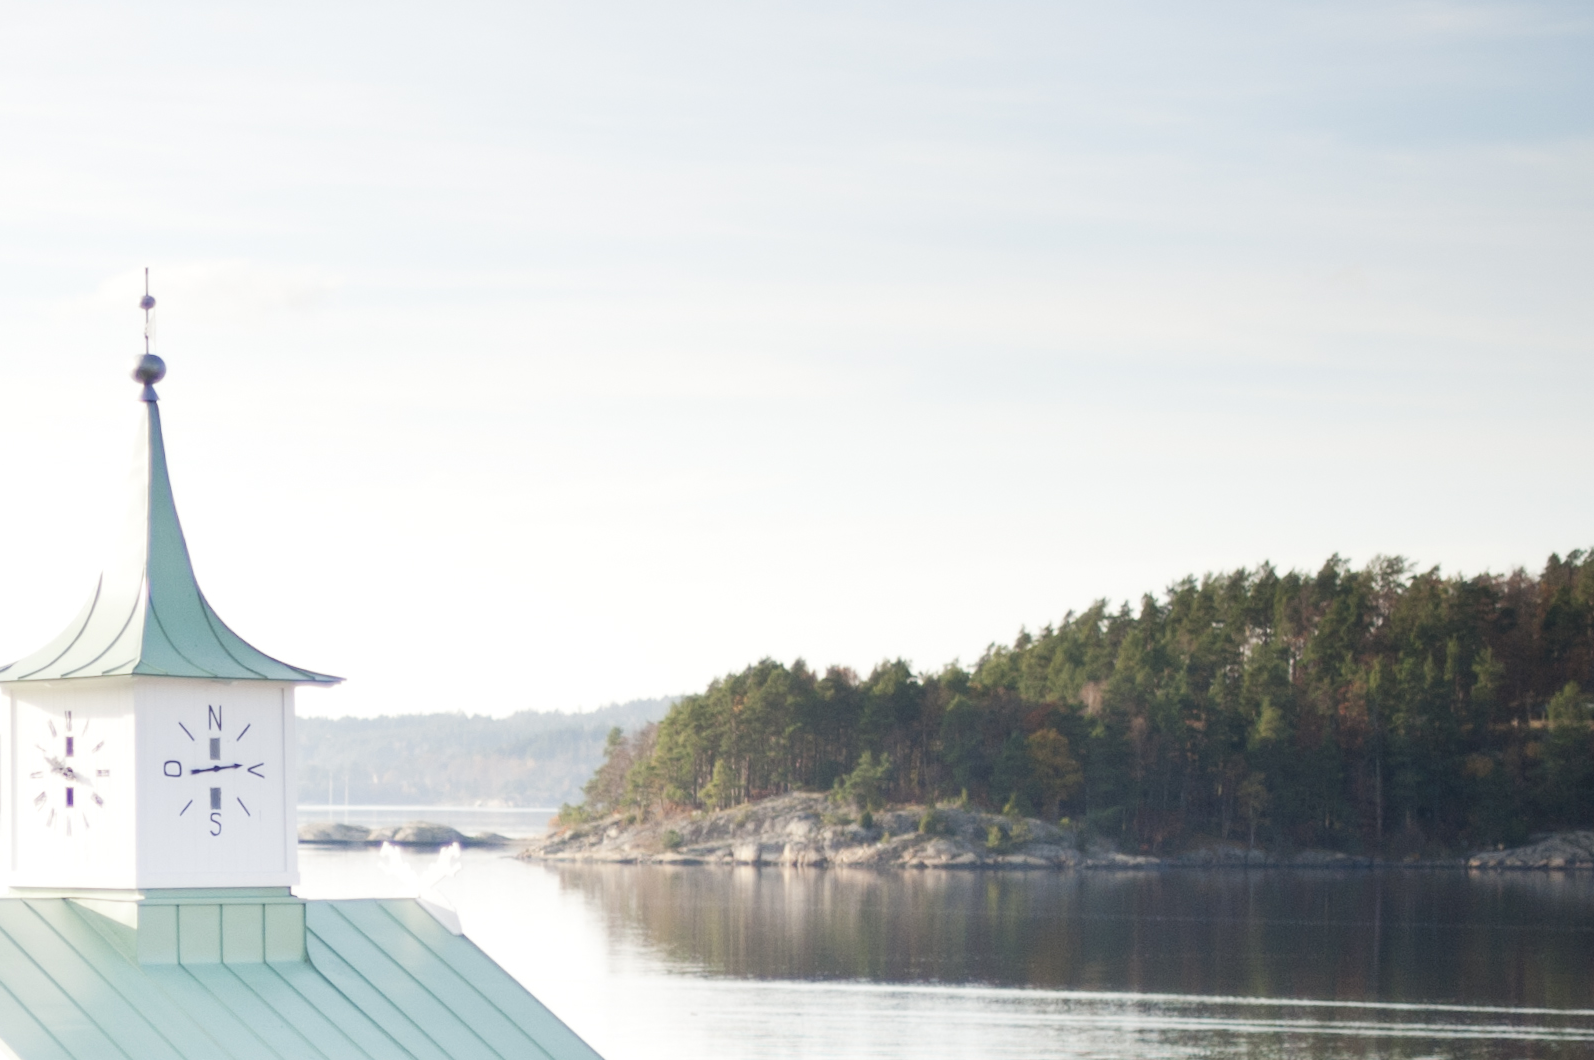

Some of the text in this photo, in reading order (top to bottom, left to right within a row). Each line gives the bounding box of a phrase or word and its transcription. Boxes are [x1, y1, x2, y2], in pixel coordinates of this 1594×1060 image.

[208, 704, 222, 732] N
[163, 760, 183, 778] O
[209, 812, 222, 837] S
